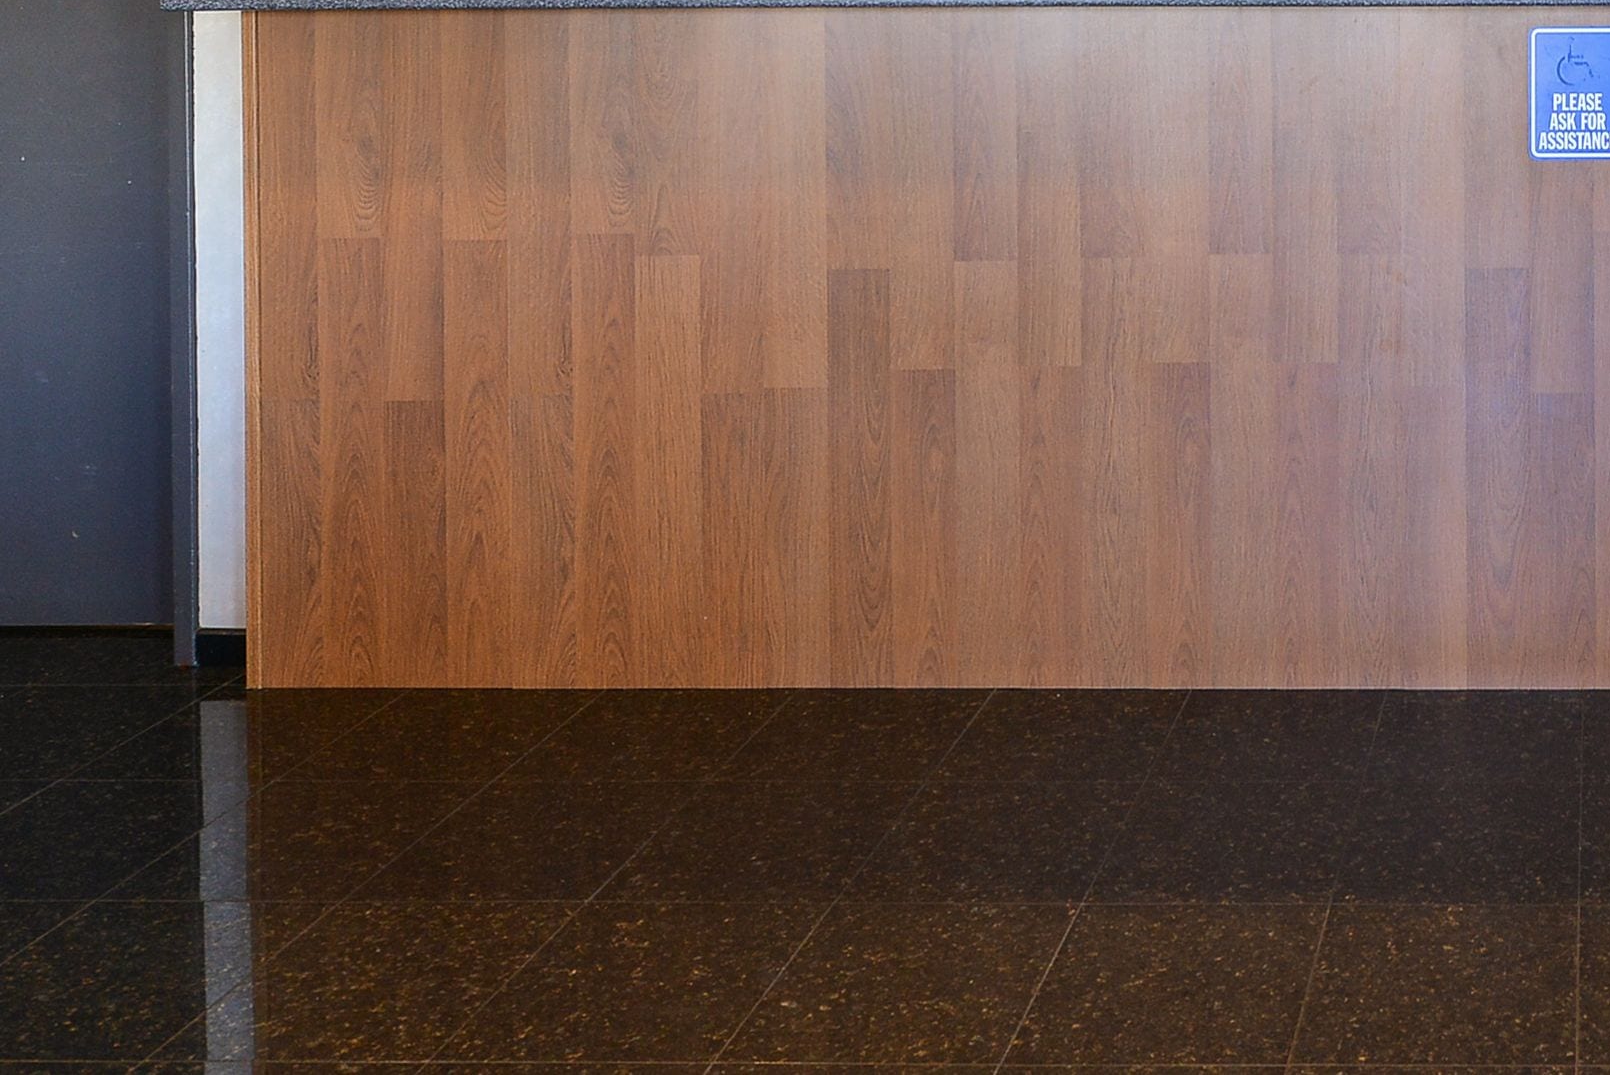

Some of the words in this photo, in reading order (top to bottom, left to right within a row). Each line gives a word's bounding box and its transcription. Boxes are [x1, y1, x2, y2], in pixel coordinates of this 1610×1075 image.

[1552, 92, 1603, 111] PLEASE
[1549, 112, 1577, 131] ASK
[1581, 112, 1606, 131] FOR
